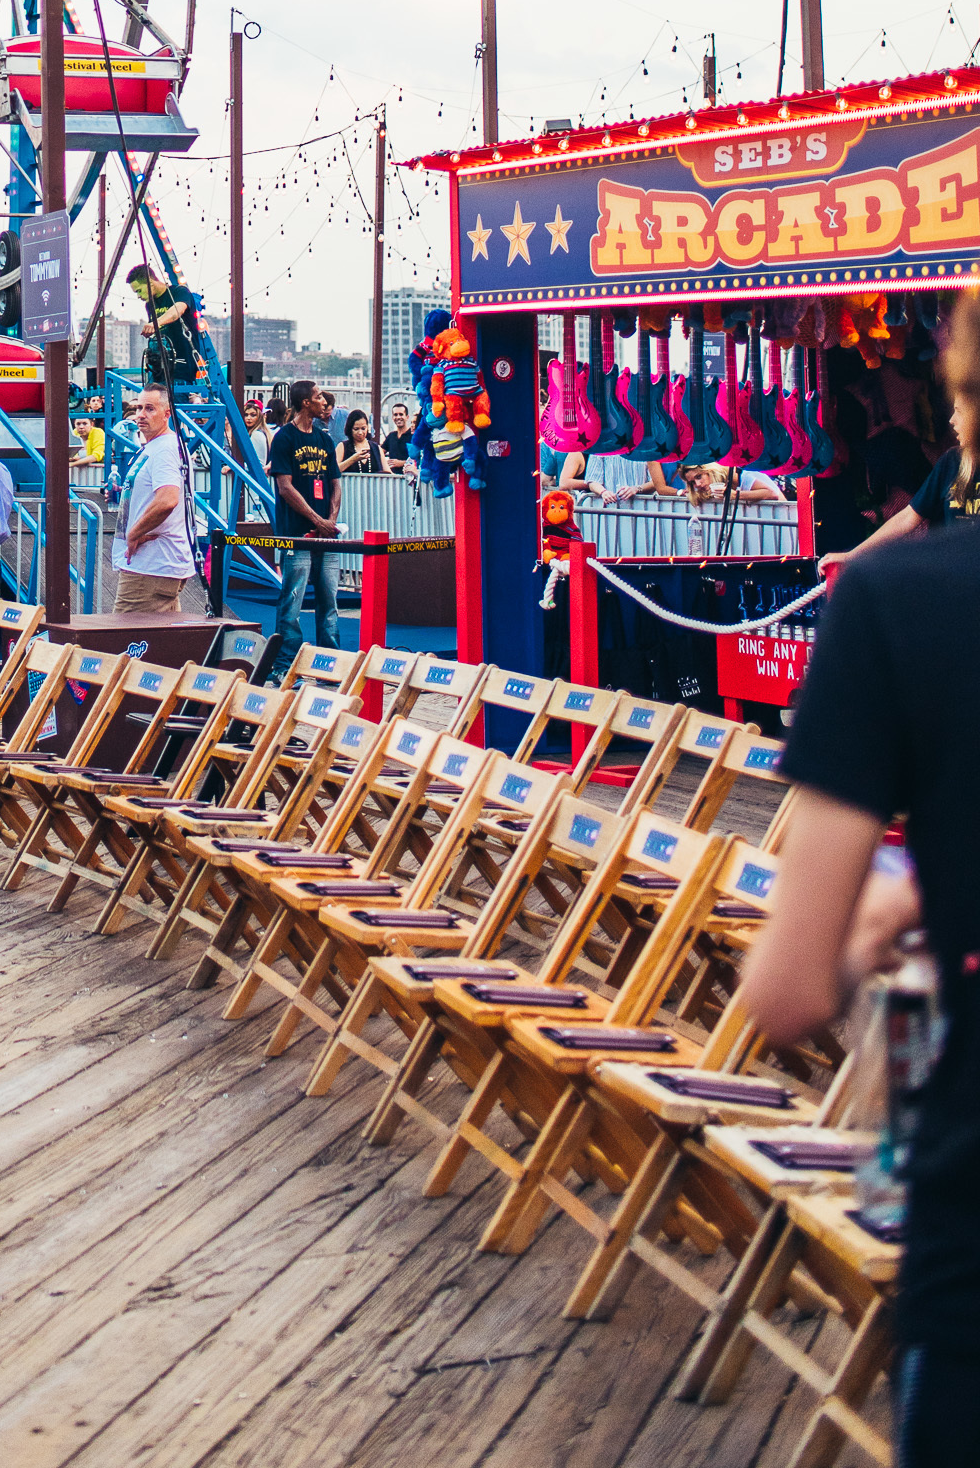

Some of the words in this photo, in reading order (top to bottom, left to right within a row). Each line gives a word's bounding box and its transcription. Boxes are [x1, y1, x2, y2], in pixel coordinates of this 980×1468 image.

[63, 62, 95, 70] estival
[596, 143, 980, 266] ARCADE
[225, 536, 247, 545] YORK
[248, 537, 274, 548] WATER
[275, 539, 294, 549] TAXI
[387, 543, 404, 553] NEW
[405, 542, 425, 552] YORK
[425, 540, 448, 550] WATER
[738, 637, 765, 657] RING
[773, 642, 797, 661] ANY
[756, 659, 779, 678] WIN
